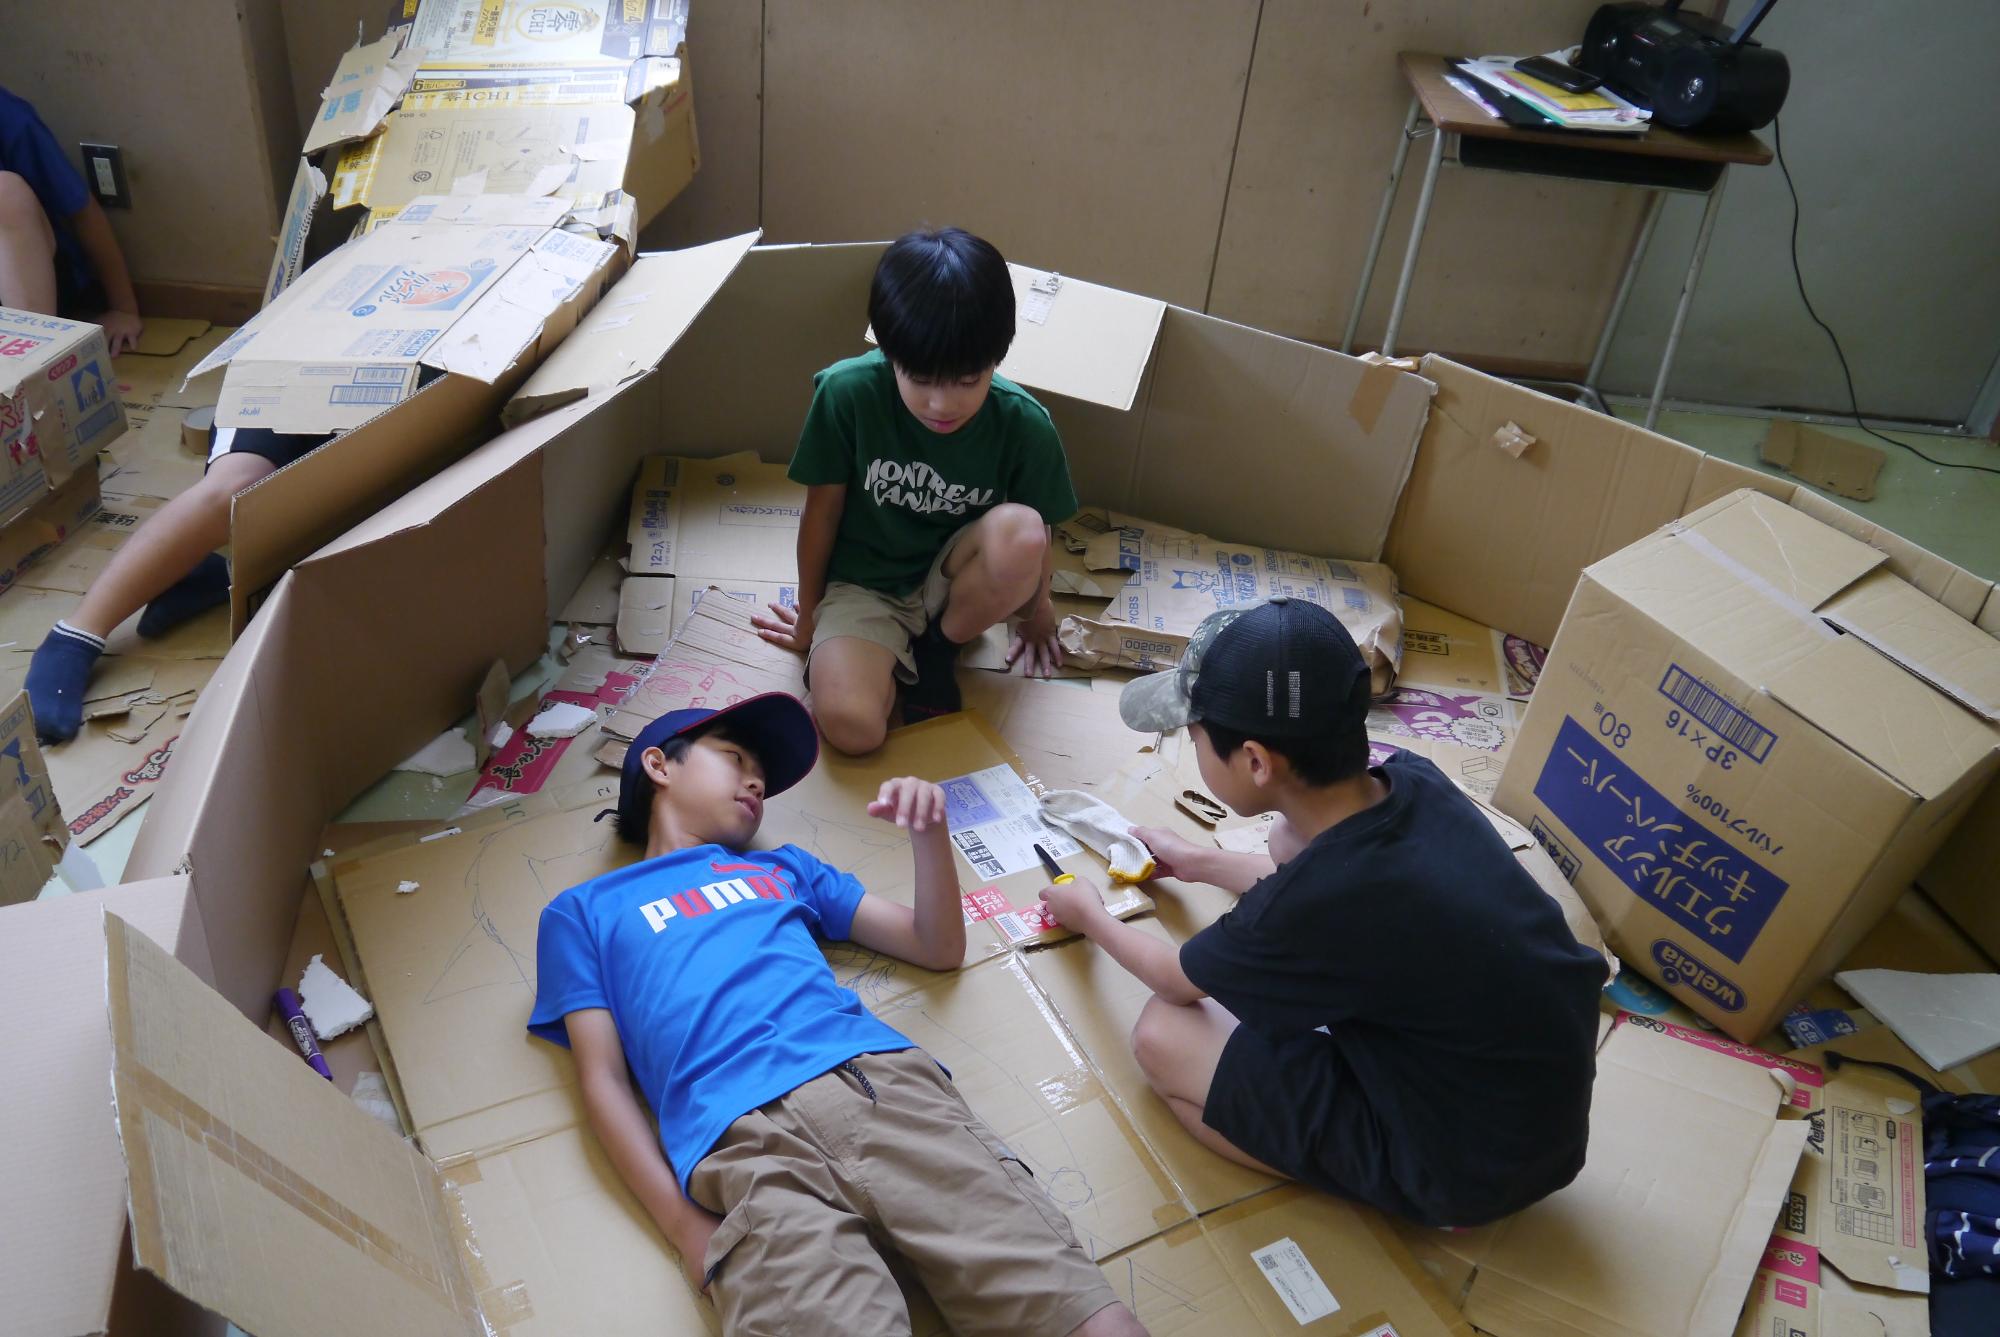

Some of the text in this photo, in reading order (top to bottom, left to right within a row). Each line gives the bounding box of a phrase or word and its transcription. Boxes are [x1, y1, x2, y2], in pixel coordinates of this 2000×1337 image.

[528, 8, 546, 34] ICHI
[864, 458, 994, 506] MONTREAL
[873, 479, 966, 516] CANADA
[1567, 747, 1756, 903] キッチンペーパー
[1686, 782, 1785, 857] パルプ100%
[639, 877, 785, 934] PUMA
[1603, 835, 1738, 936] ウエルシア
[1660, 946, 1741, 1008] welcia
[1789, 1194, 1807, 1234] 65323
